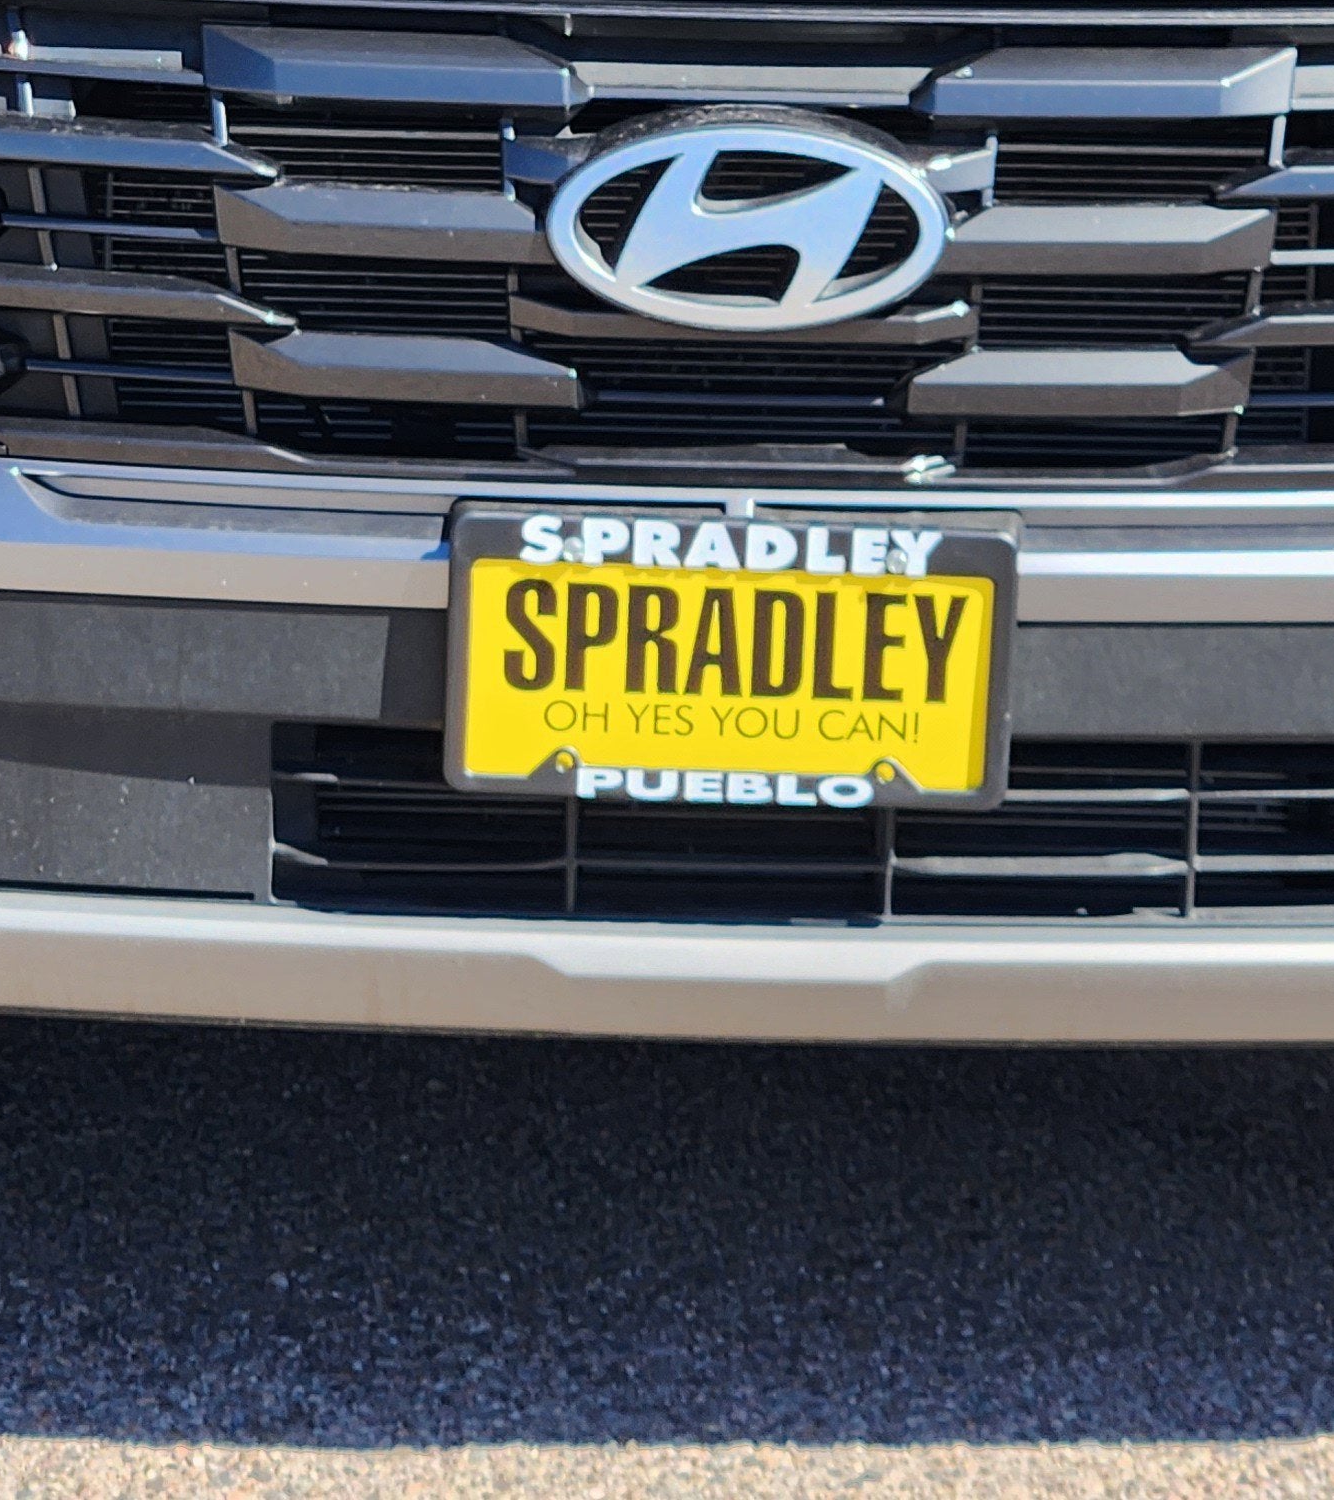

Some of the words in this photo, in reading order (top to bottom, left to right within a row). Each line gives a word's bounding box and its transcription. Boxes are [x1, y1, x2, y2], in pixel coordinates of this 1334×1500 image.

[520, 514, 943, 577] SPRADLEY
[503, 578, 970, 704] SPRADLEY
[544, 700, 609, 733] OH
[626, 703, 695, 737] YES
[711, 706, 801, 740] YOU
[817, 709, 920, 744] CAN!
[576, 766, 875, 809] PUEBLO
